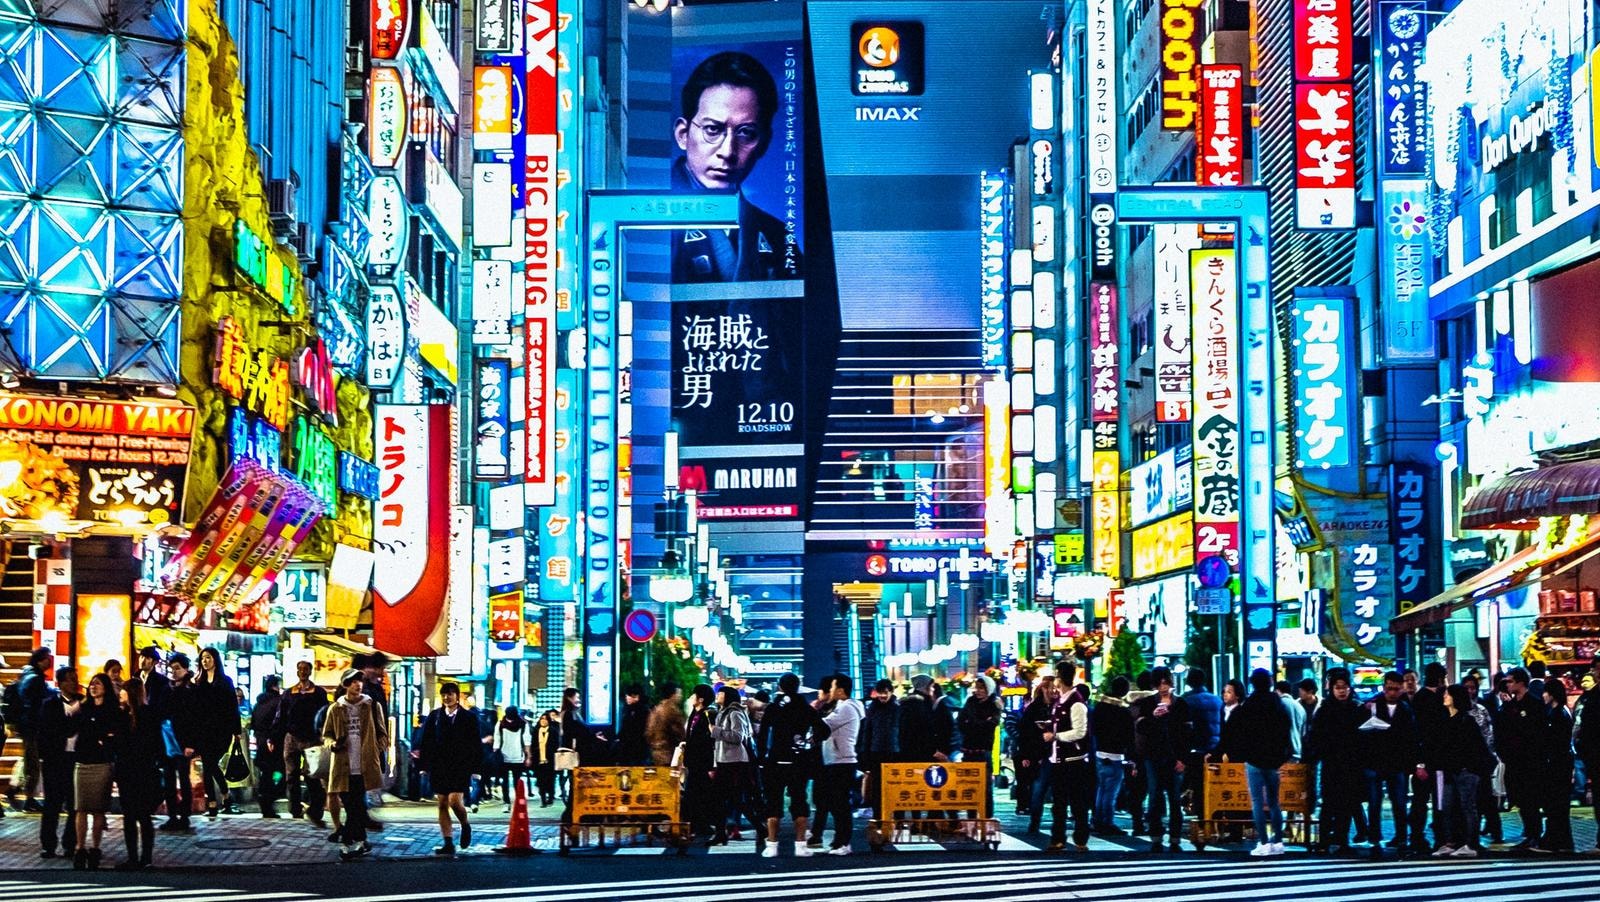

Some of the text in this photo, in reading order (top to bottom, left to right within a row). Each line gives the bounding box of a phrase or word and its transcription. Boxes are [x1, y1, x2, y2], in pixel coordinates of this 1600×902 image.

[526, 0, 556, 77] AX
[1163, 0, 1198, 128] ooth
[855, 107, 919, 121] IMAX
[1482, 134, 1508, 174] Don
[526, 155, 548, 306] BIC DRUG
[681, 313, 769, 351] 海賊と
[681, 350, 763, 373] よばれた
[681, 374, 713, 409] 男
[1303, 304, 1344, 460] カラオケ
[123, 405, 194, 433] YAKI
[591, 257, 611, 571] GODZILLA ROAD
[737, 402, 794, 424] 12.10
[738, 424, 793, 433] ROADSHOW
[53, 445, 90, 460] Drinks
[91, 447, 107, 461] for
[108, 448, 117, 461] 2
[118, 449, 151, 463] hours
[382, 416, 406, 526] トラノコ
[1198, 414, 1239, 515] 金の蔵
[714, 467, 797, 489] MARUHAN
[1198, 526, 1232, 553] 2F
[1398, 470, 1426, 594] カラオケ
[938, 557, 996, 573] CIEM
[1353, 543, 1382, 645] カラオケ
